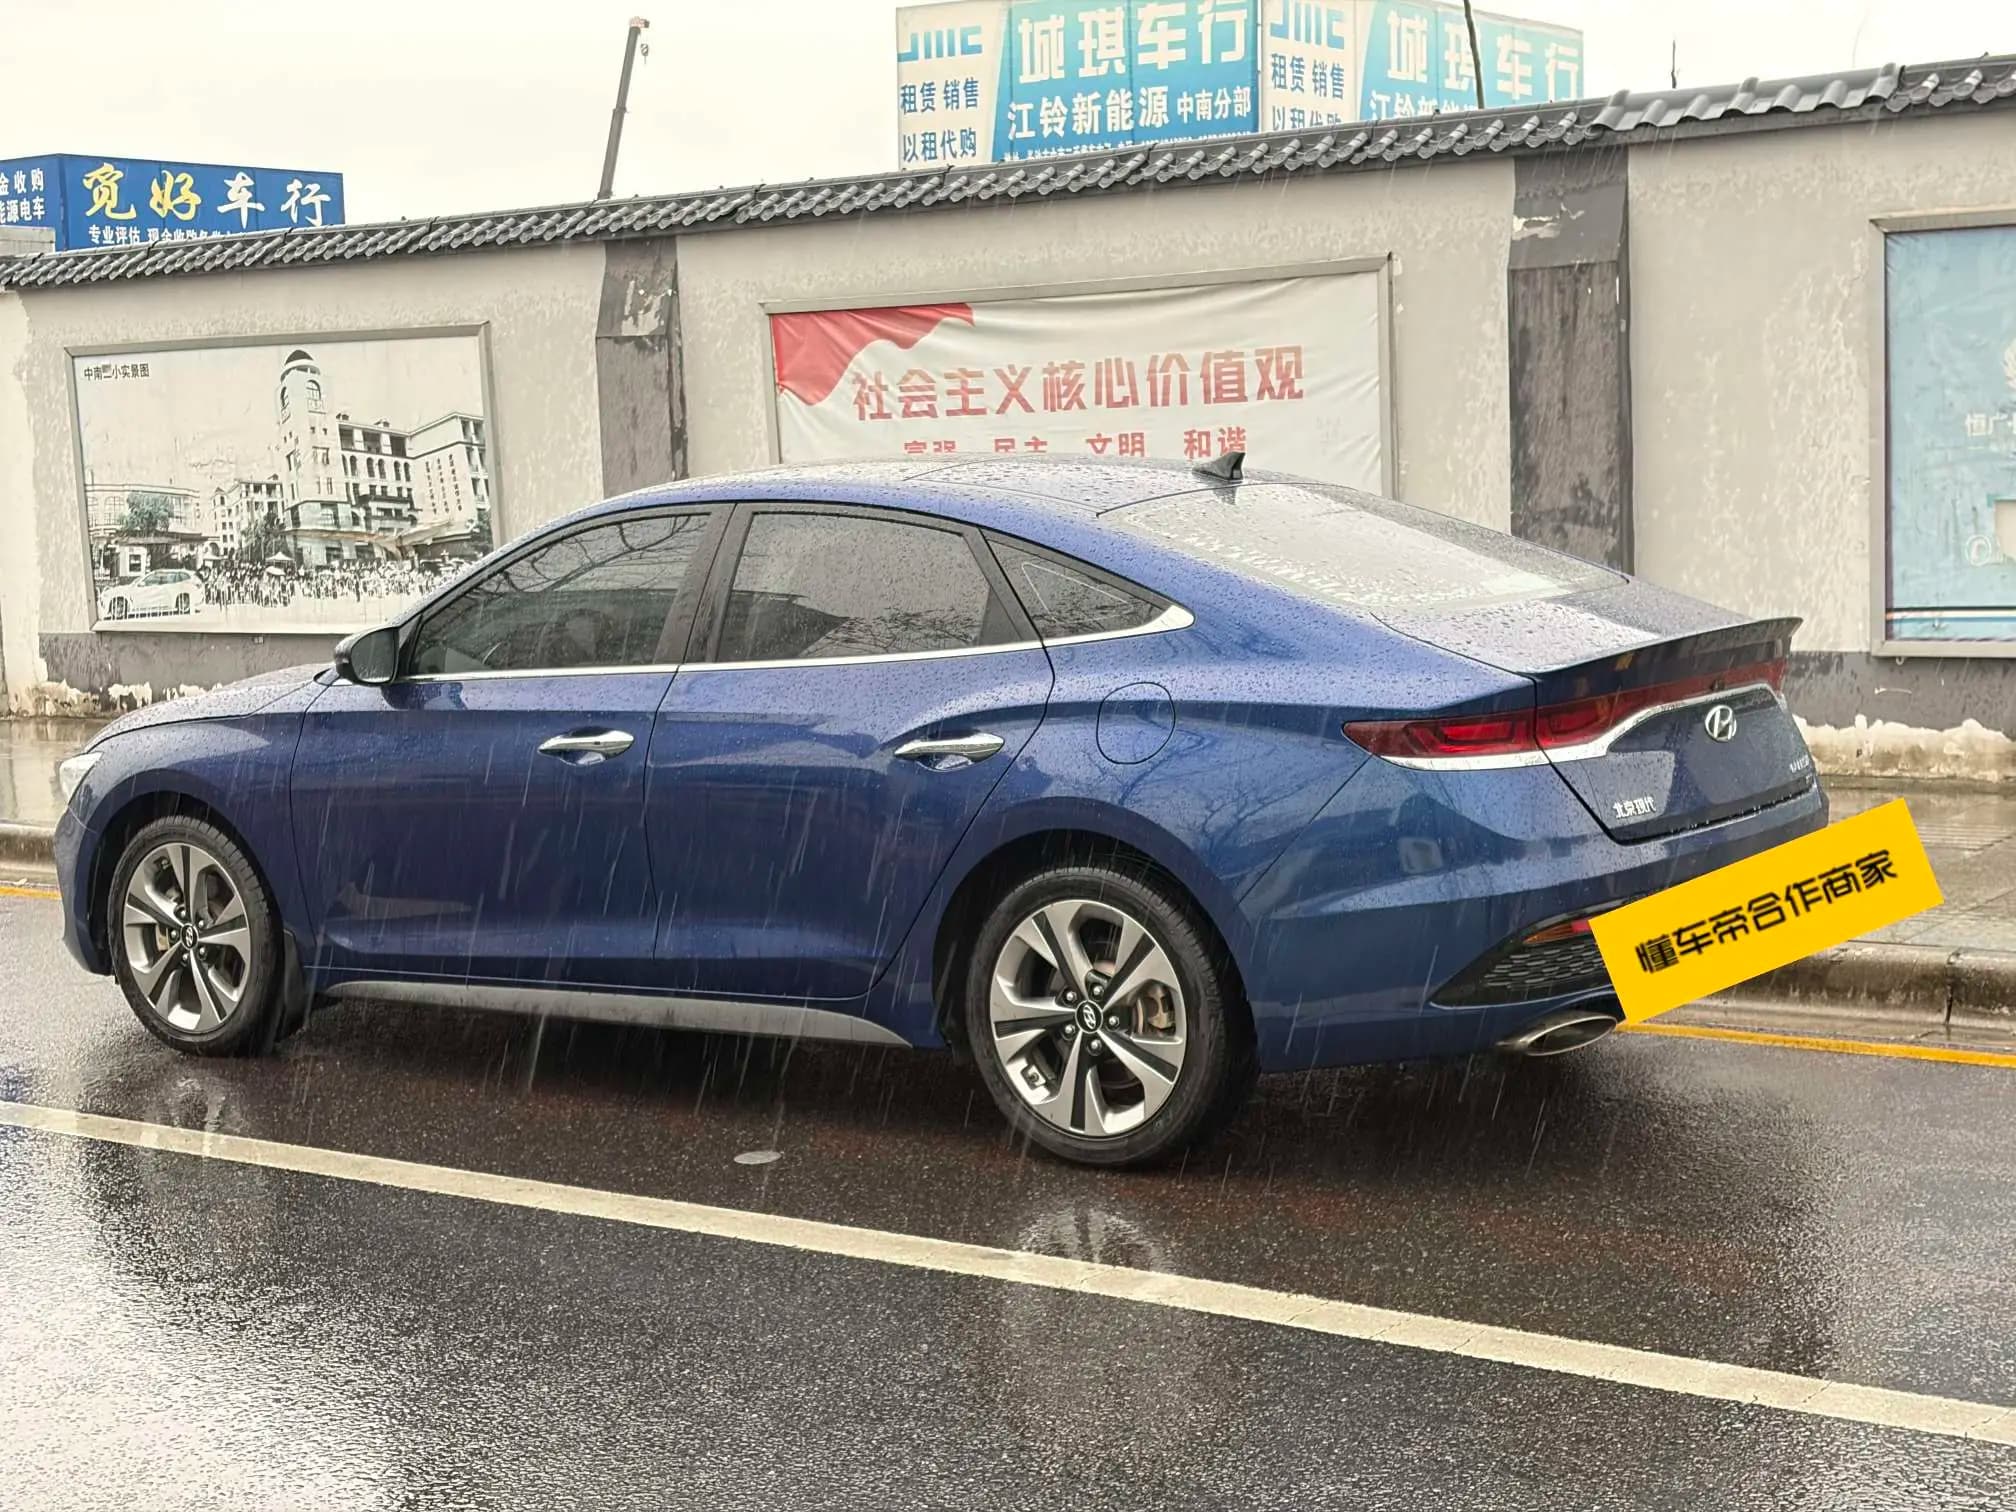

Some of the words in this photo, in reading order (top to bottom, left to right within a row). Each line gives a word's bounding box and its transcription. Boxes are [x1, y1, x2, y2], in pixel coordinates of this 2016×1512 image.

[1271, 53, 1305, 94] 租赁
[1312, 59, 1345, 100] 销售
[900, 81, 936, 115] 租赁
[943, 76, 979, 110] 销售
[1008, 86, 1169, 141] 江铃新能源
[1177, 86, 1252, 125] 中南分部
[903, 127, 977, 162] 以租代购
[88, 224, 141, 245] 专业评估
[852, 345, 1304, 422] 社会主义核心价值观
[1085, 432, 1145, 457] 文明
[1183, 426, 1247, 460] 和谐
[1612, 796, 1657, 819] 北京现代
